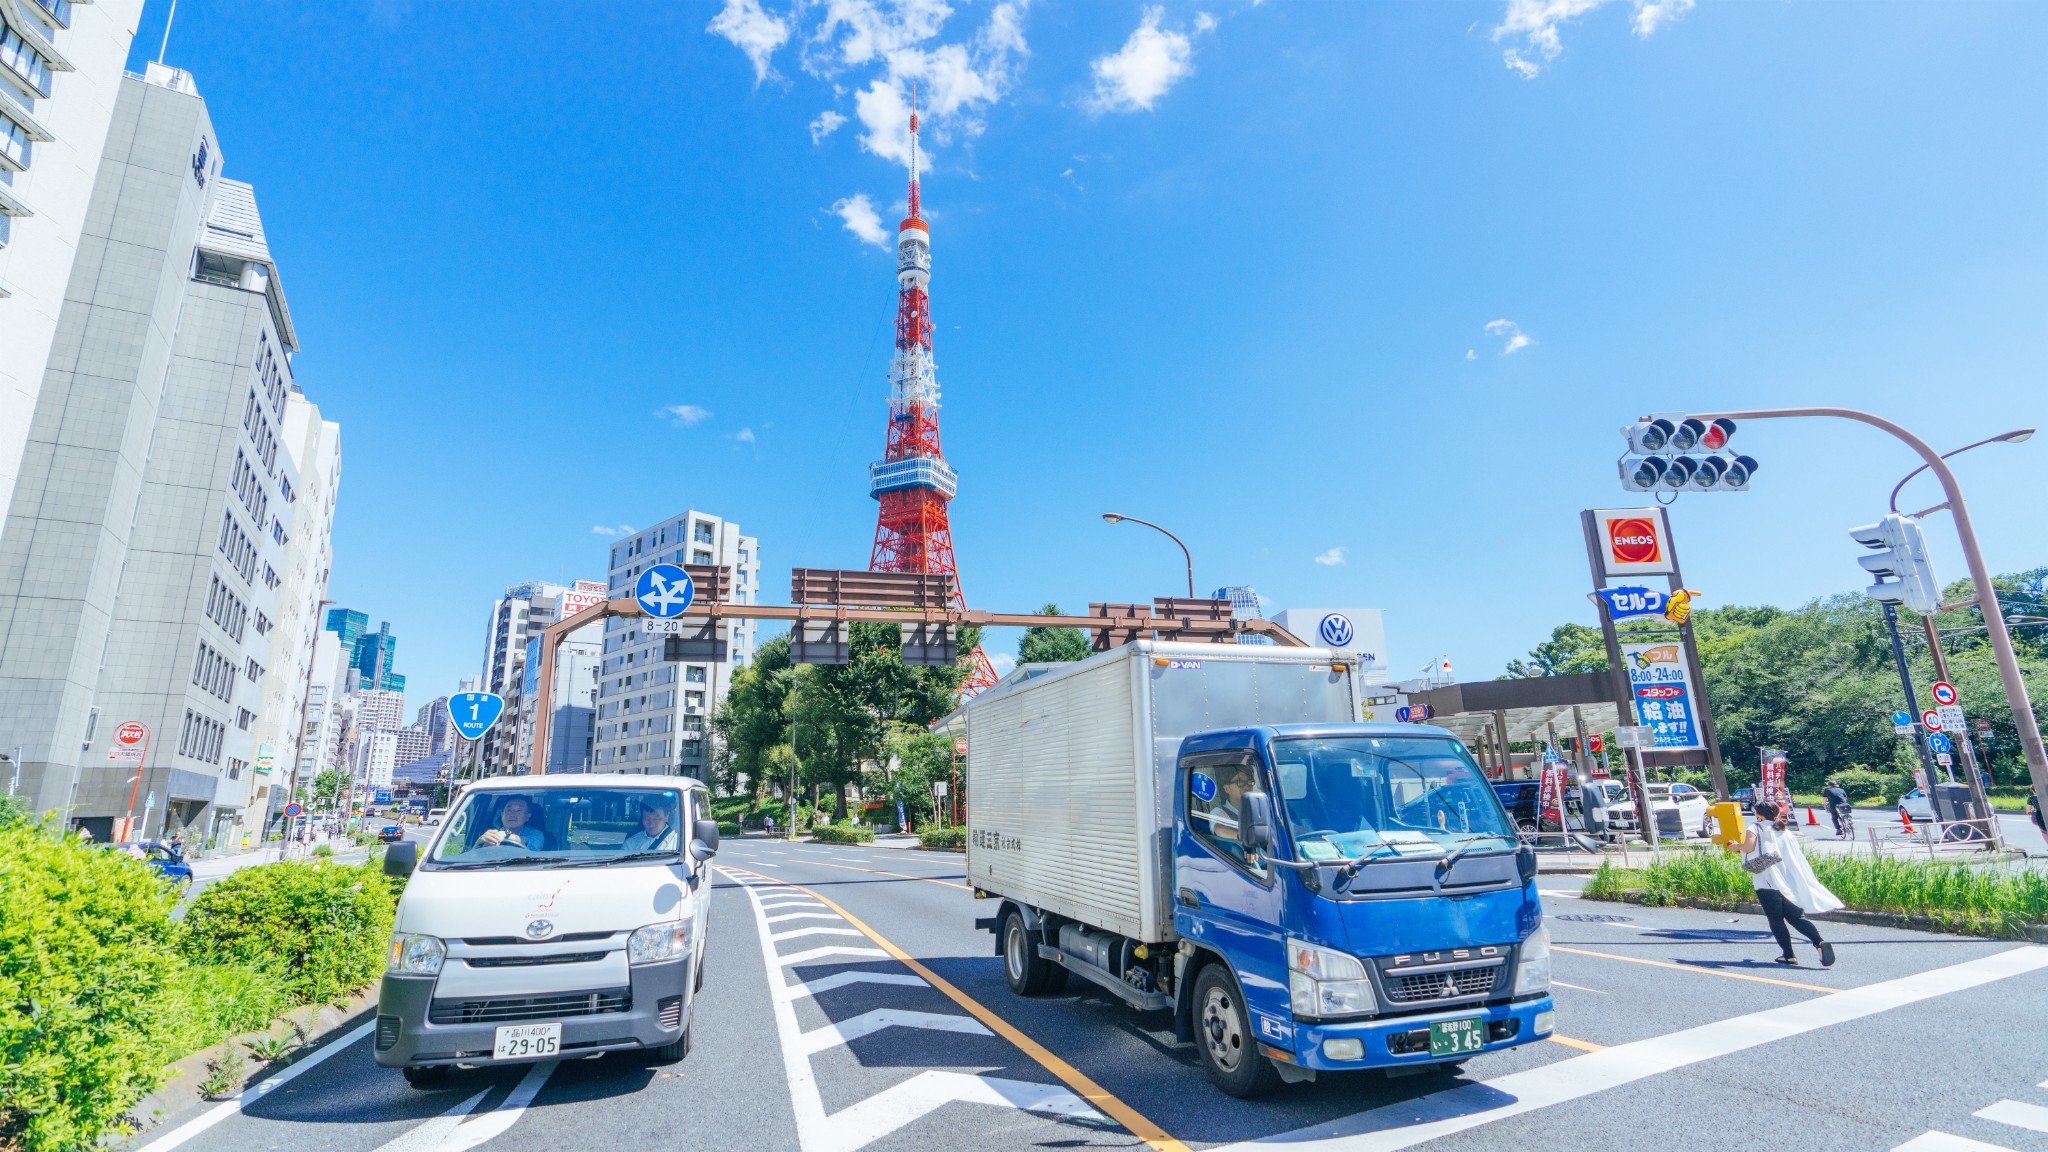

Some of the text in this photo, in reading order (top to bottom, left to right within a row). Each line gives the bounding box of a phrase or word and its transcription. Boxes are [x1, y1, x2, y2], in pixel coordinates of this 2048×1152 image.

[1614, 535, 1654, 545] ENEOS
[1610, 592, 1661, 611] セルフ
[647, 620, 678, 631] 8-20
[1651, 650, 1673, 660] フル
[1642, 687, 1680, 697] スタッフが
[469, 703, 479, 720] 1
[1642, 701, 1687, 720] 給油
[1928, 715, 1939, 725] 40
[1933, 738, 1942, 751] P
[1394, 946, 1498, 965] FUSO
[497, 1037, 557, 1056] は 29-05
